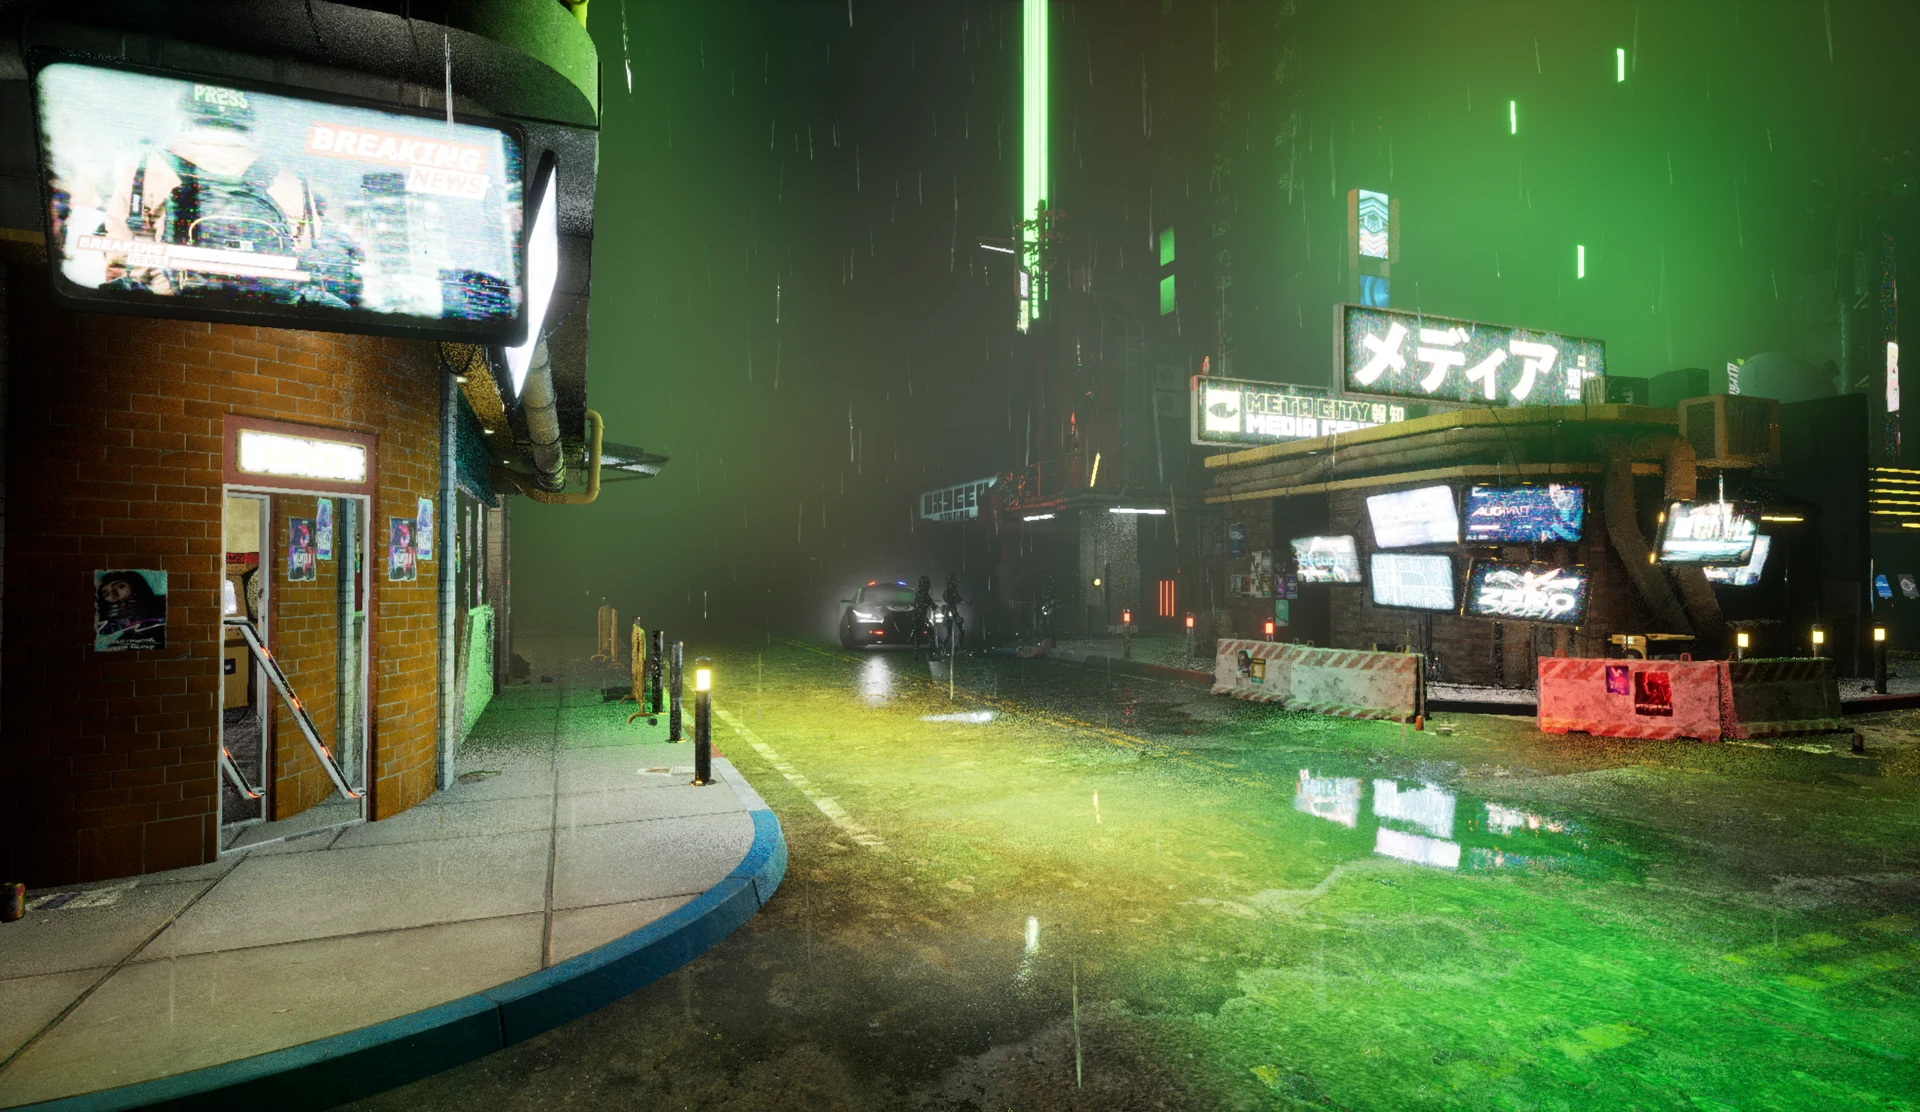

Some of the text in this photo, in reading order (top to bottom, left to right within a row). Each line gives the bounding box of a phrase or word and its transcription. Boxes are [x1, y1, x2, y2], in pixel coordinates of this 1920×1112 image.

[194, 84, 248, 109] PRESS
[311, 126, 481, 172] BREAKING
[412, 169, 484, 195] NEWS
[79, 236, 165, 256] BREAKING
[129, 253, 165, 267] NEWS
[1355, 321, 1559, 401] メディア
[1317, 397, 1370, 421] CITY
[1246, 412, 1317, 438] MEDIA
[266, 447, 345, 471] OPEN
[1478, 587, 1575, 611] ZERO
